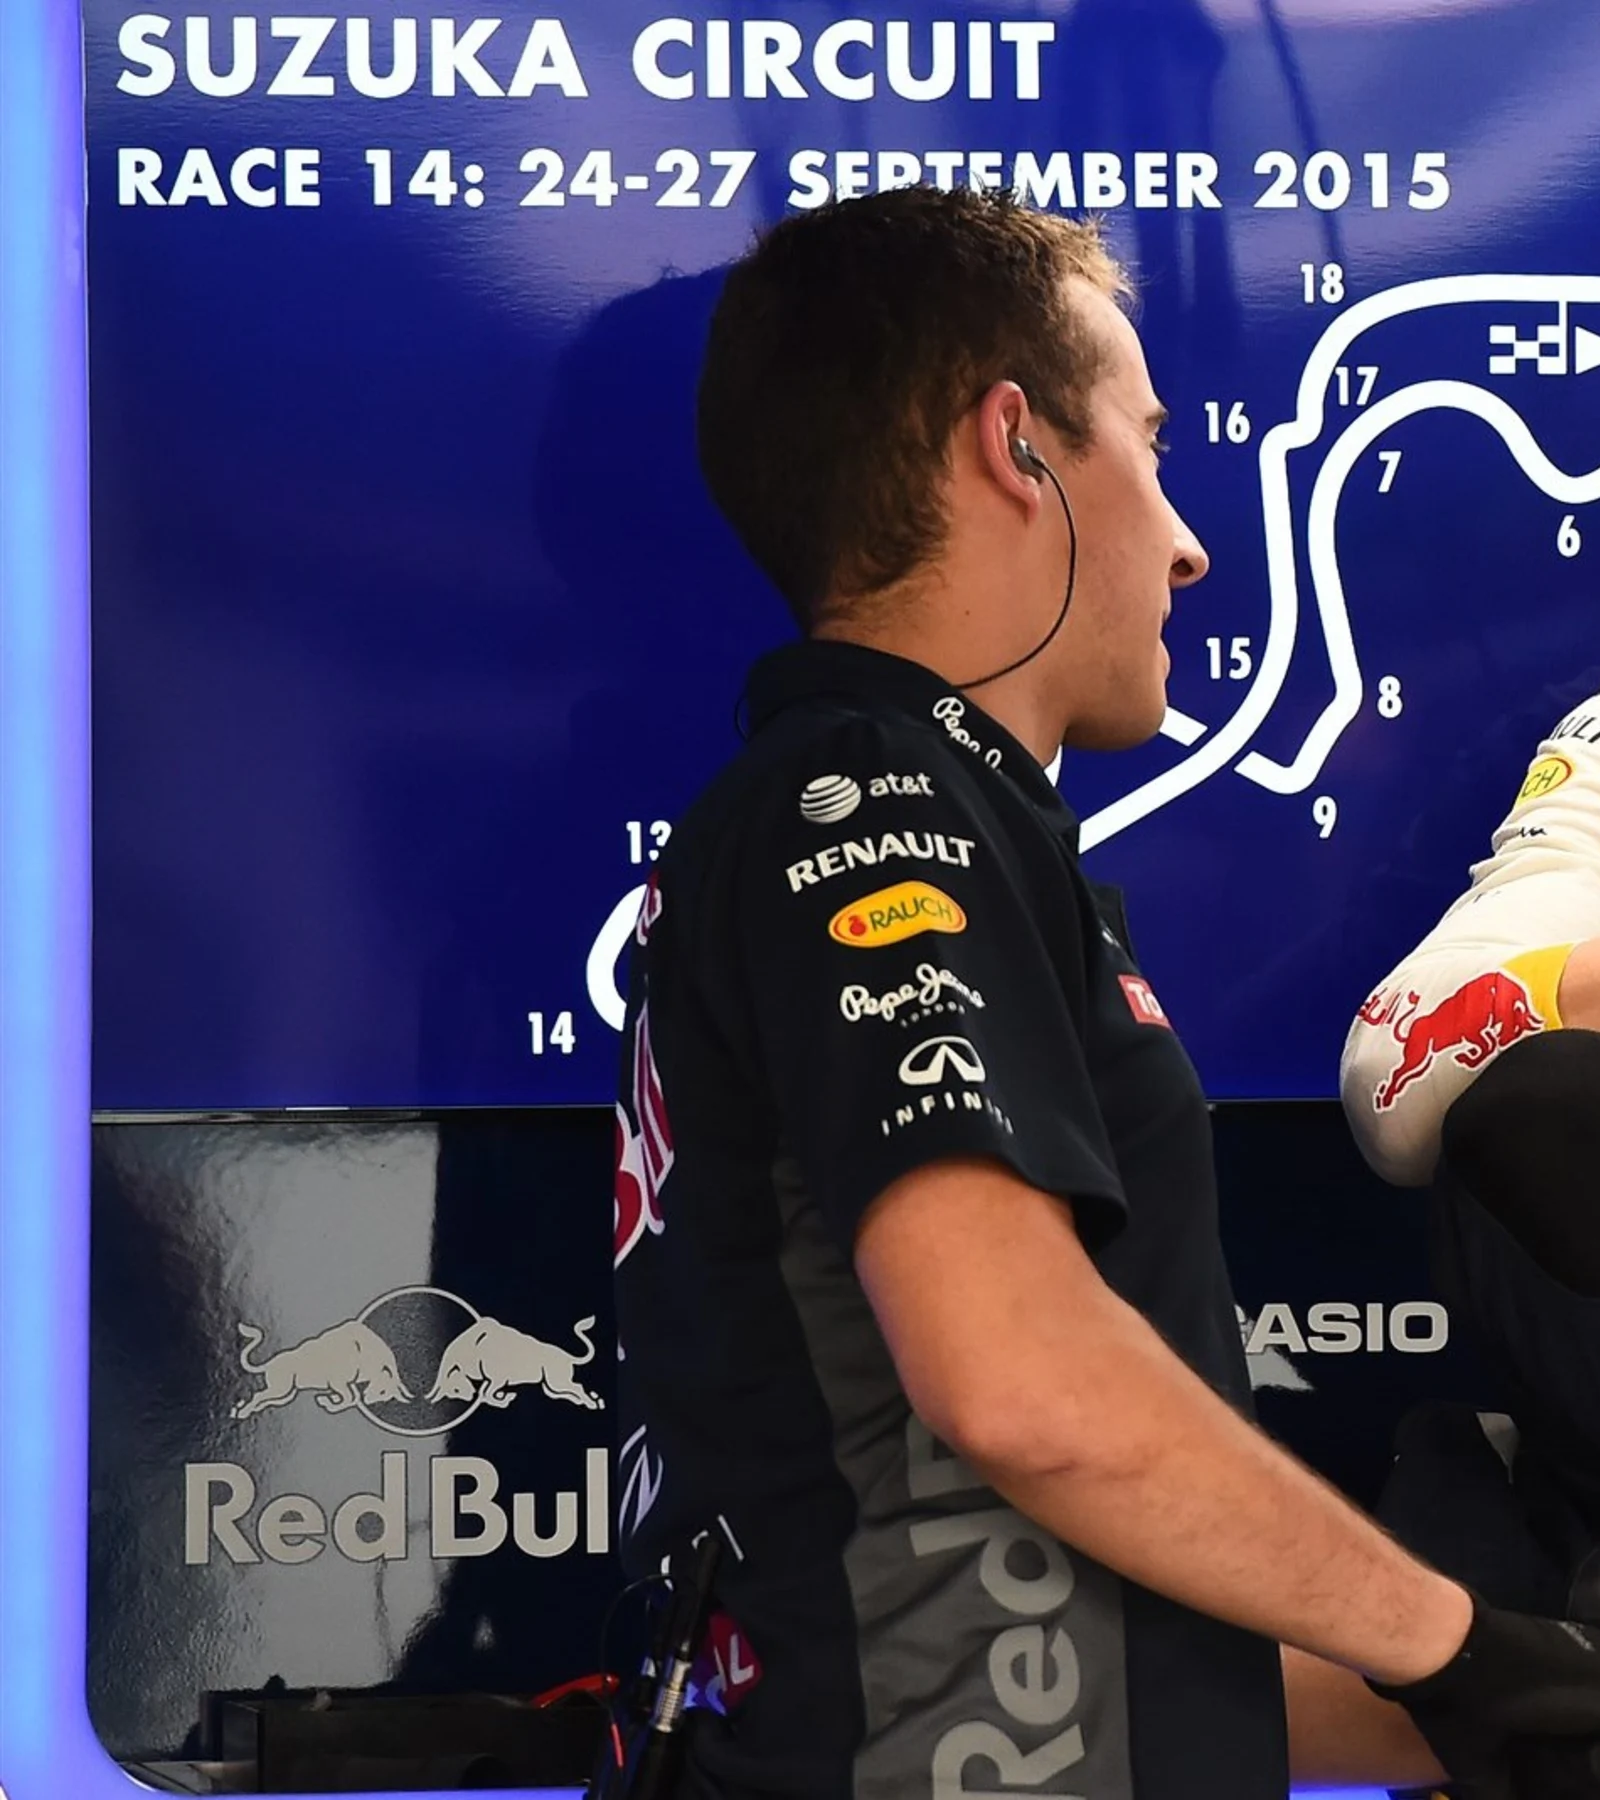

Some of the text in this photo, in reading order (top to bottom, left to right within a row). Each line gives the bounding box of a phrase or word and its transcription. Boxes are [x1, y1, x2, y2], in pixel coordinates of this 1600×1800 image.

[116, 14, 1055, 101] SUZUKA CIRCUIT
[118, 147, 1450, 210] RACE 14: 24-27 SEPTEMBER 2015
[1300, 263, 1345, 304] 18
[1335, 366, 1378, 406] 17
[1205, 401, 1250, 444] 16
[1378, 451, 1402, 493] 7
[1557, 515, 1581, 557] 6
[1206, 637, 1253, 681] 15
[1377, 676, 1403, 718] 8
[1312, 796, 1337, 838] 9
[786, 831, 975, 893] RENAULT
[868, 896, 952, 931] RAUCH
[840, 984, 919, 1022] Pepe
[528, 1011, 576, 1055] 14
[881, 1091, 1014, 1136] INFINITI
[1236, 1302, 1449, 1353] ASIO
[184, 1448, 609, 1564] Red Bul
[909, 1507, 1087, 1800] Red
